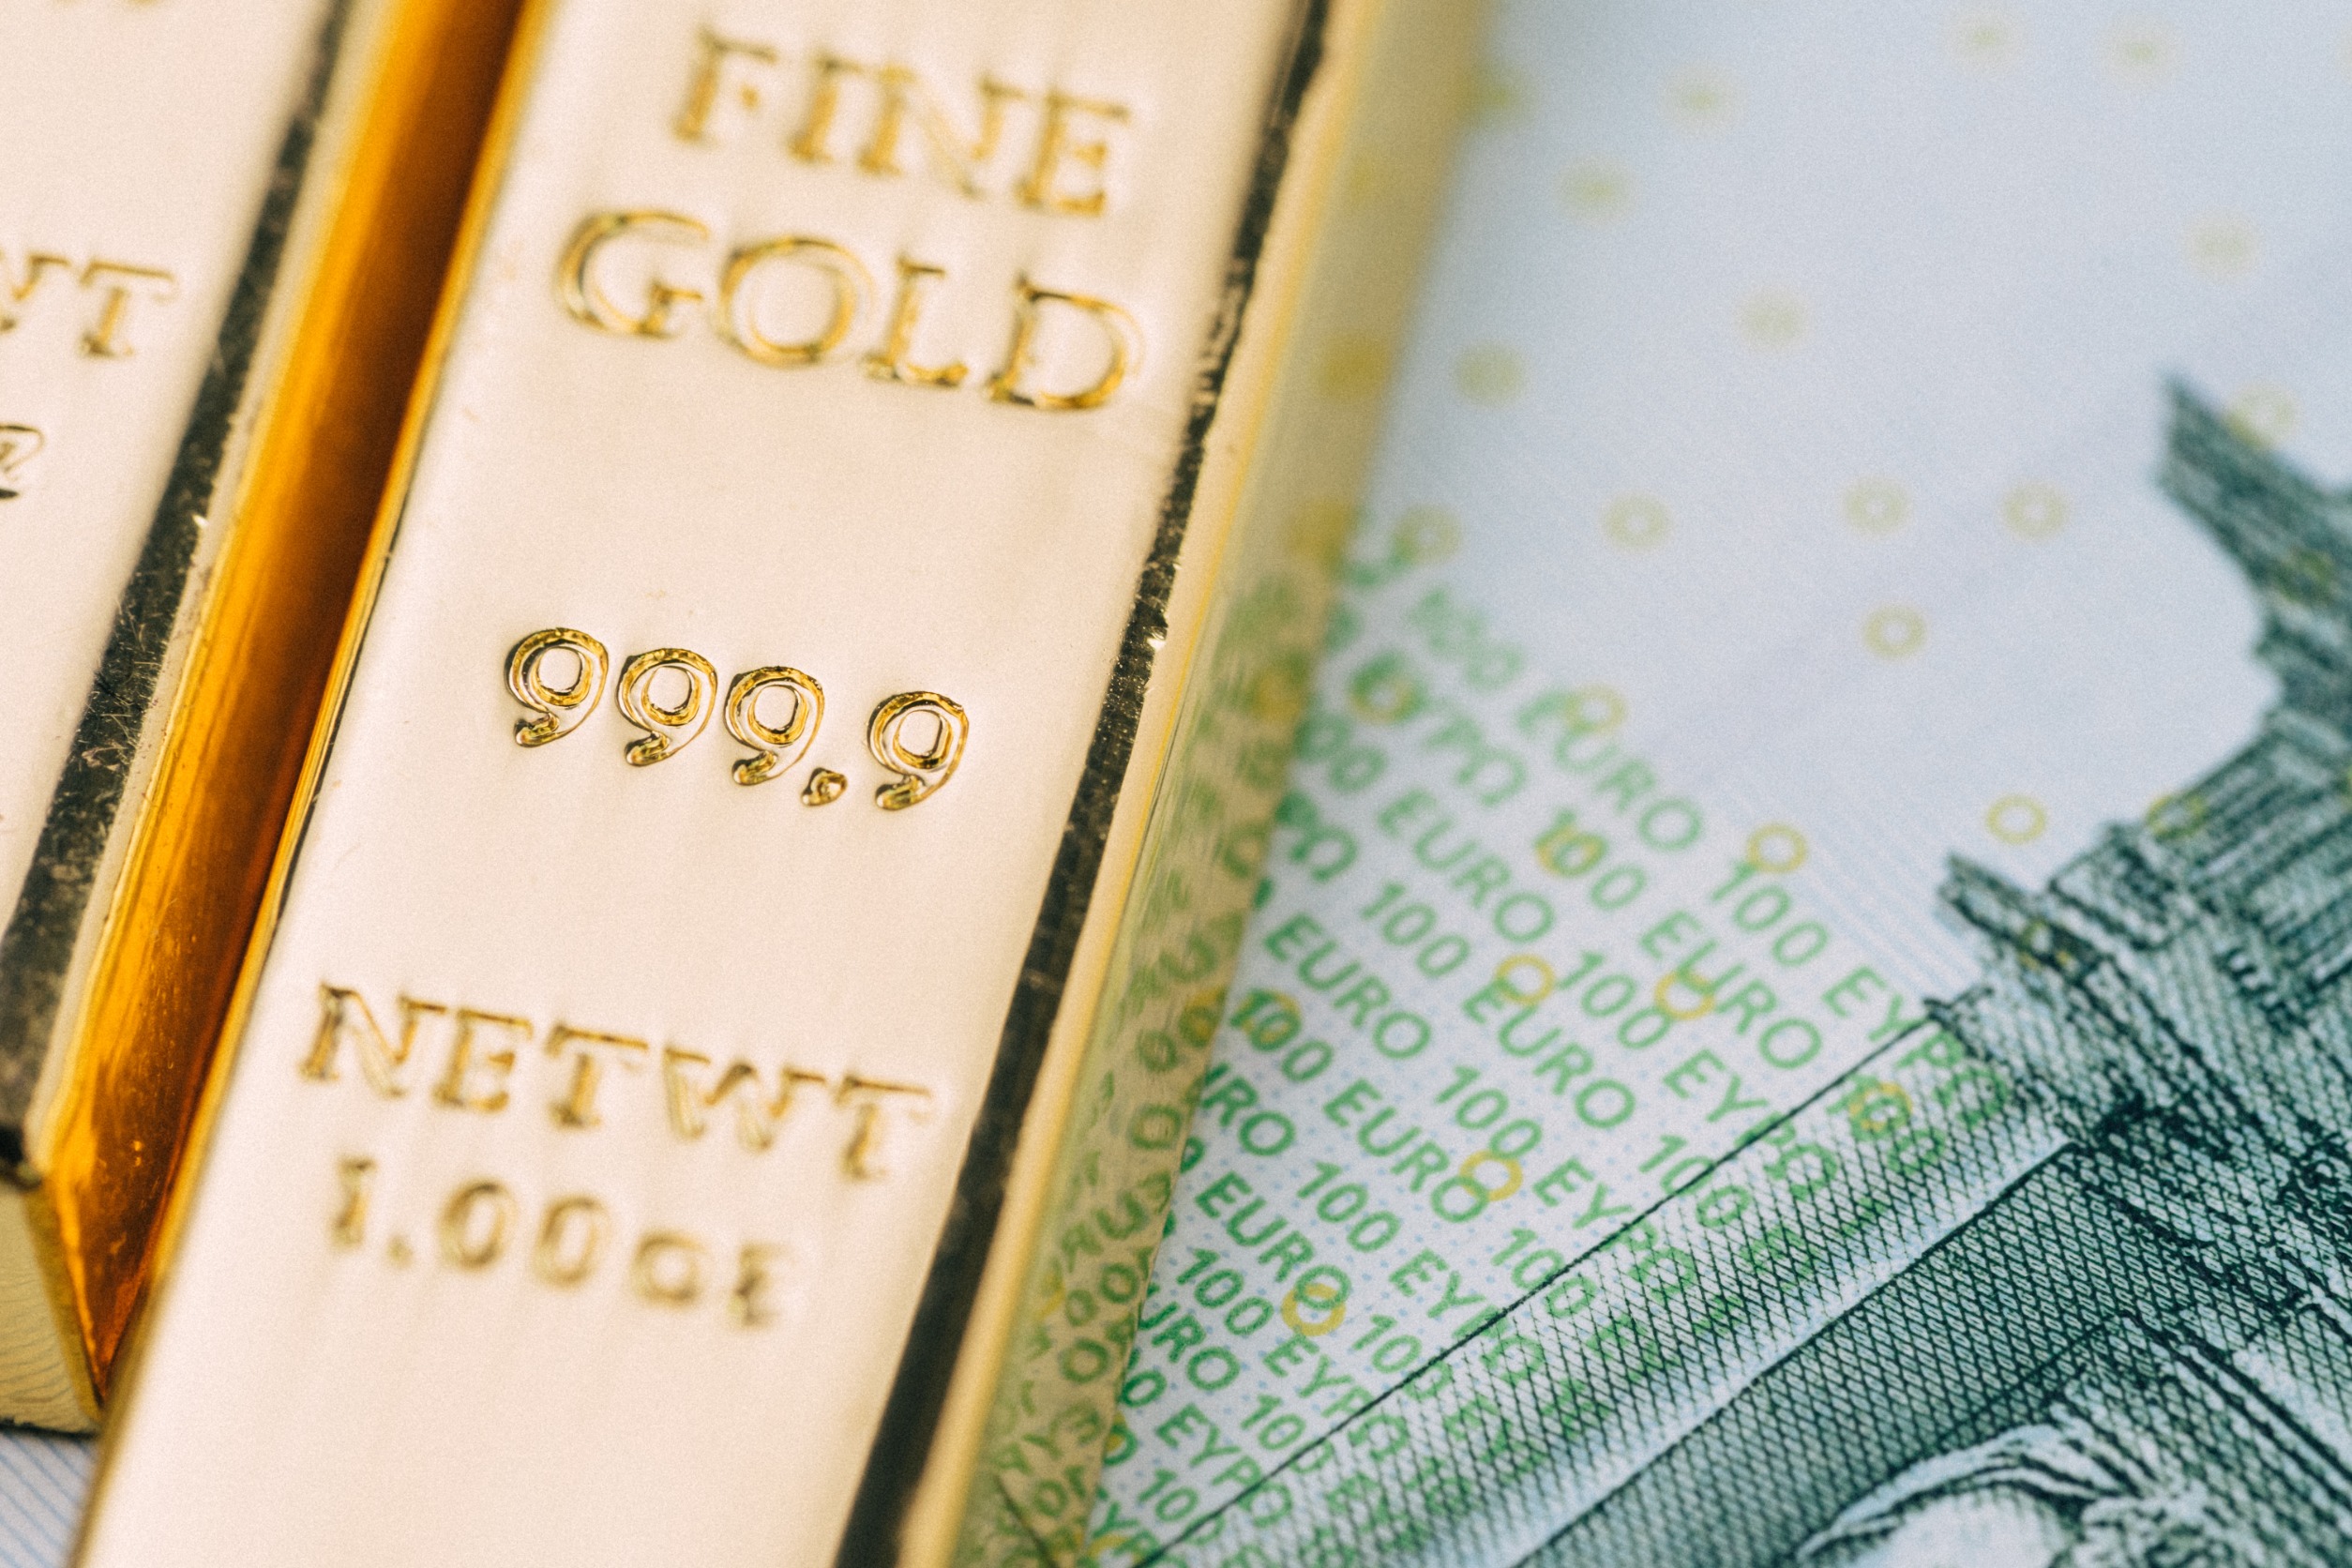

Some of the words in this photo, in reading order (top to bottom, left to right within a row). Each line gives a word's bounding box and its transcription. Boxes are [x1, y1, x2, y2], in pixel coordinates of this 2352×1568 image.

[674, 23, 1130, 218] FINE
[556, 207, 1146, 413] GOLD
[1378, 788, 1557, 943] EURO
[1558, 950, 1672, 1049] 100
[1515, 687, 1704, 852] EURO
[1711, 859, 1829, 968] 100
[1263, 913, 1431, 1060] EURO
[1436, 1065, 1543, 1160] 100
[1361, 881, 1470, 978] 100
[1462, 976, 1635, 1128] EURO
[1640, 1135, 1751, 1229] 100
[1639, 911, 1822, 1069] EURO
[1195, 1171, 1352, 1311] EURO
[1229, 988, 1334, 1082] 100
[1323, 1079, 1489, 1221] EURO
[1492, 1229, 1596, 1318] 100
[1297, 1162, 1401, 1253] 100
[1177, 1248, 1274, 1336] 100
